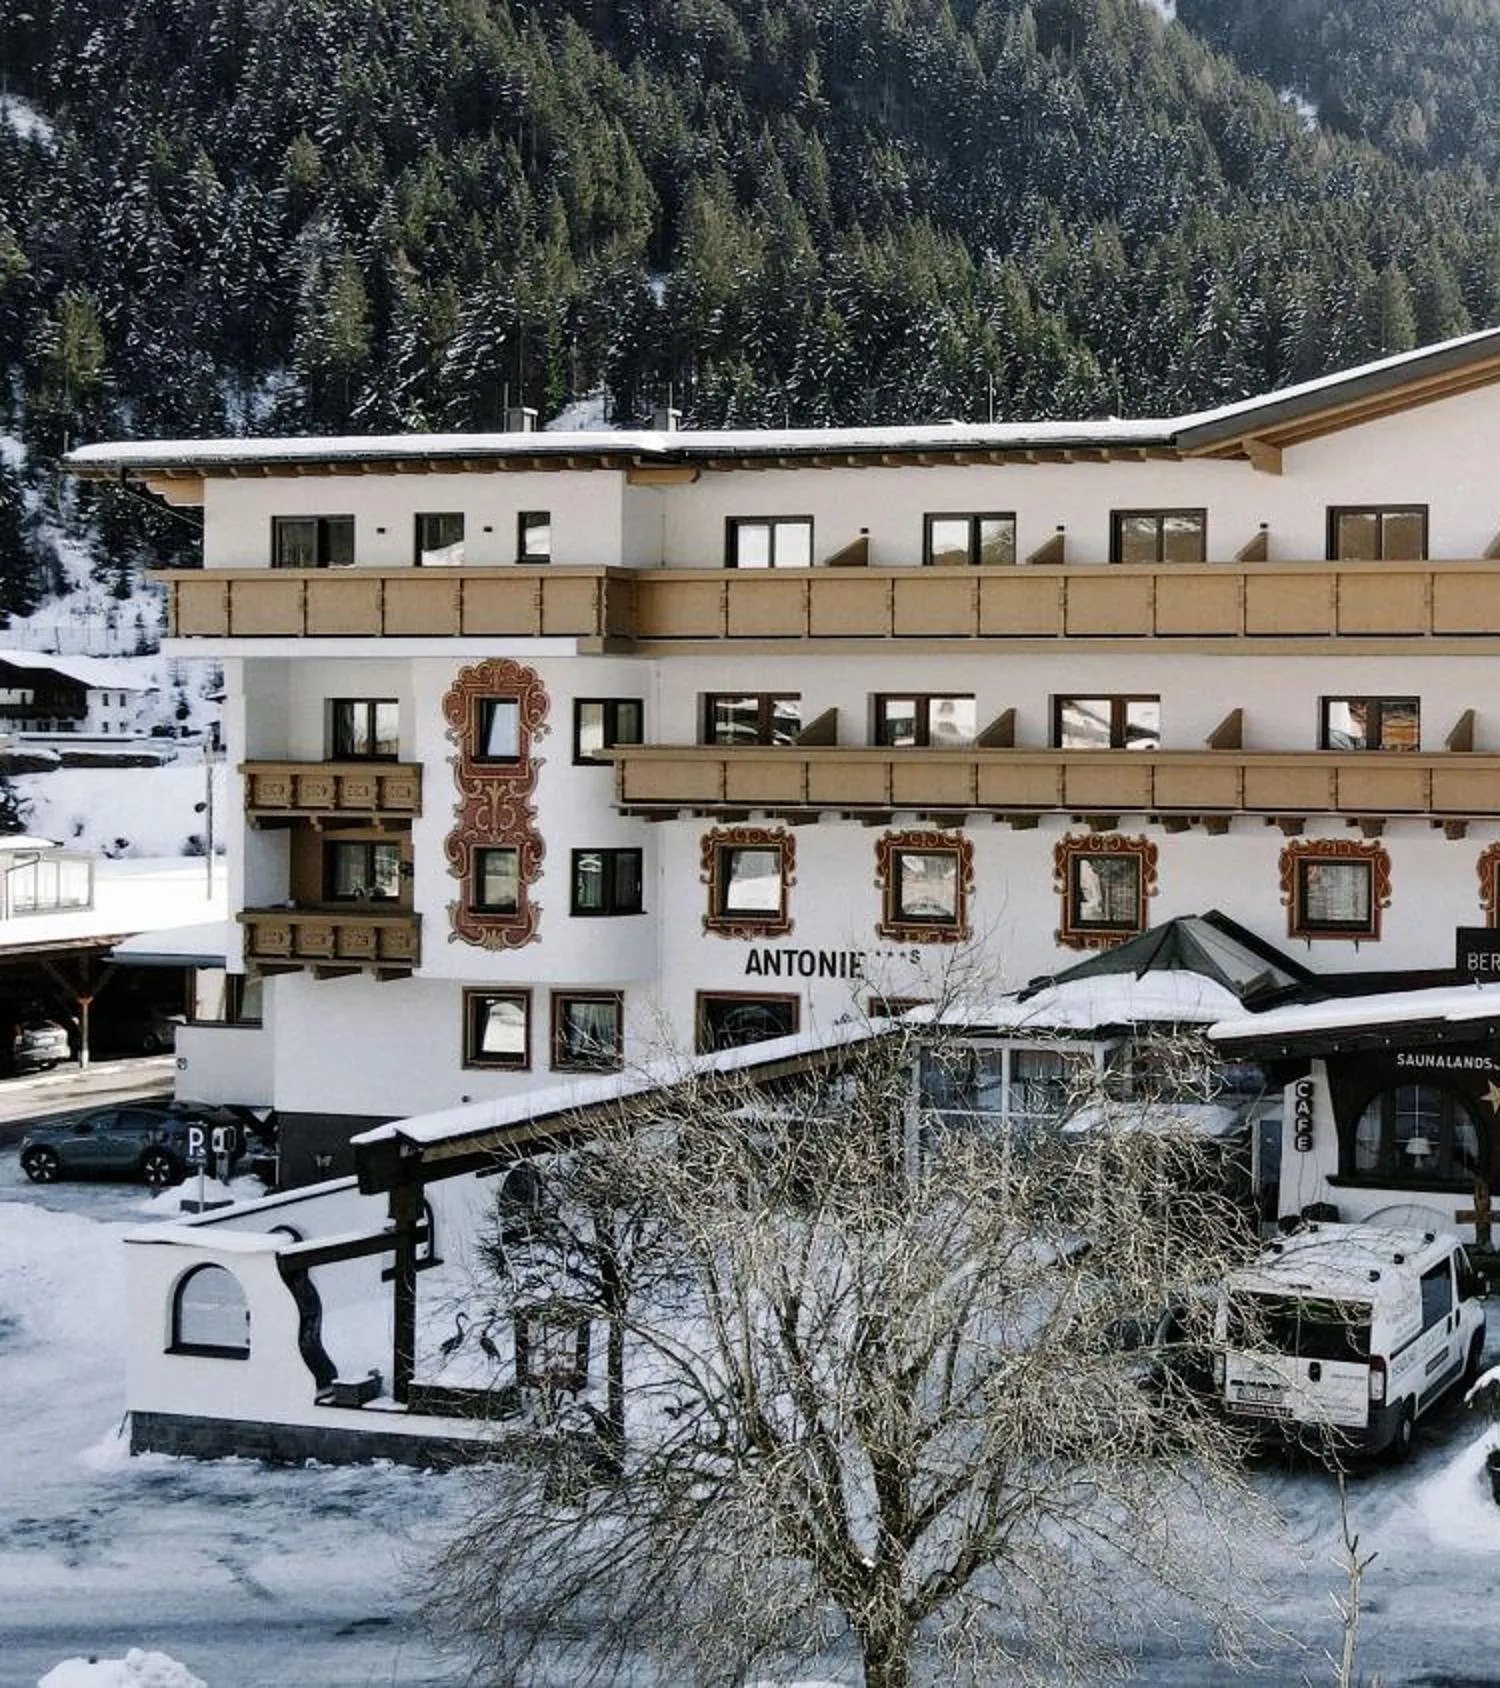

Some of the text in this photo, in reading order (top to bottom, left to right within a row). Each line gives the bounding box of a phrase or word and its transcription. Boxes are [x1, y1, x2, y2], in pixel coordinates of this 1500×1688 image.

[745, 949, 865, 978] ANTONIE
[1296, 1082, 1311, 1151] CAFE
[189, 1127, 204, 1156] P
